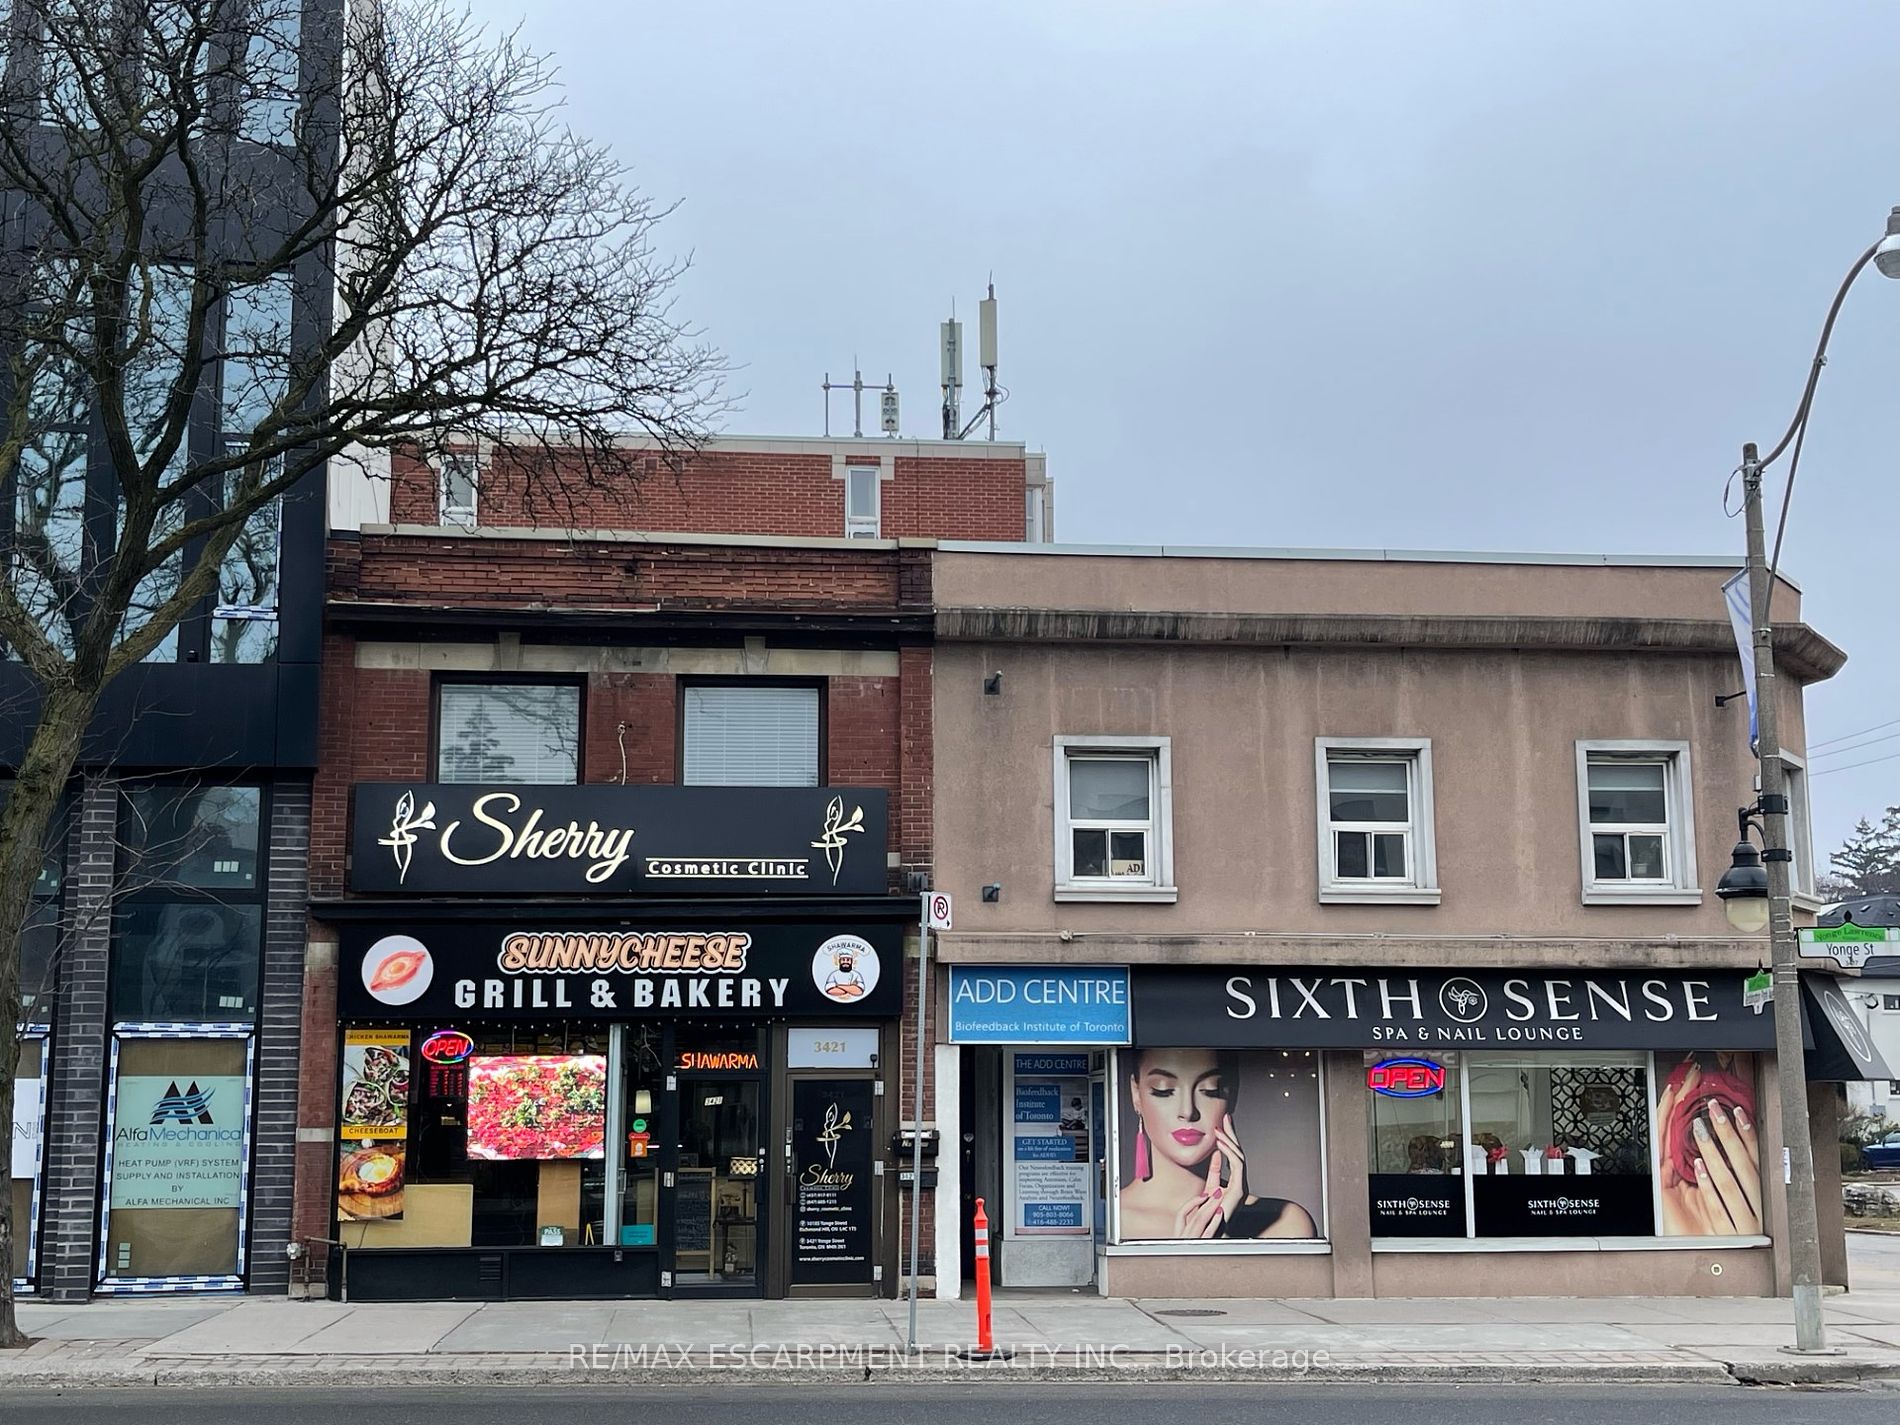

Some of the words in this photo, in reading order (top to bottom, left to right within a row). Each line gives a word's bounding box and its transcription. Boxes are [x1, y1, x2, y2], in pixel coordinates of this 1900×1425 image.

[440, 792, 635, 883] Sherry
[647, 860, 741, 877] Cosmetic
[747, 859, 806, 877] Clinic
[498, 932, 752, 974] SUNNYCHEESE
[826, 942, 866, 953] SHAWARMA
[1826, 943, 1860, 959] Yonge
[1863, 943, 1874, 955] St
[454, 978, 572, 1009] GRILL
[589, 978, 617, 1009] &
[633, 977, 791, 1008] BAKERY
[955, 979, 1016, 1004] ADD
[1023, 979, 1125, 1004] CENTRE
[1225, 976, 1424, 1020] SIXTH
[1505, 979, 1718, 1022] SENSE
[955, 1021, 1020, 1032] Biofeedback
[1023, 1021, 1066, 1032] Institute
[1069, 1021, 1080, 1032] of
[1084, 1021, 1125, 1032] Toronto
[1372, 1026, 1408, 1041] SPA
[1417, 1026, 1429, 1041] &
[1437, 1026, 1486, 1041] NAIL
[1496, 1026, 1583, 1041] LOUNGE
[424, 1039, 469, 1056] OPEN
[813, 1041, 846, 1053] 3421
[681, 1052, 759, 1069] SHAWARMA
[1016, 1058, 1032, 1069] THE
[1033, 1058, 1053, 1069] ADD
[1054, 1058, 1087, 1069] CENTRE
[1368, 1067, 1445, 1089] OPEN
[1016, 1086, 1059, 1096] Biofeedback
[1016, 1098, 1046, 1108] Institute
[1016, 1110, 1024, 1120] of
[1024, 1110, 1054, 1120] Toronto
[118, 1160, 143, 1168] HEAT
[145, 1160, 172, 1168] PUMP
[174, 1159, 199, 1168] (VRF)
[202, 1159, 239, 1167] SYSTEM
[116, 1172, 151, 1180] SUPPLY
[153, 1172, 173, 1180] AND
[176, 1171, 240, 1179] INSTALLATION
[800, 1163, 854, 1190] Sherry
[171, 1185, 184, 1193] BY
[125, 1198, 149, 1206] ALFA
[151, 1197, 210, 1206] MECHANICAL
[214, 1197, 230, 1205] INC
[1377, 1199, 1407, 1209] SIXTH
[1418, 1199, 1450, 1209] SENSE
[1528, 1199, 1557, 1208] SIXTH
[1568, 1199, 1600, 1208] SENSE
[544, 1228, 561, 1236] PASS
